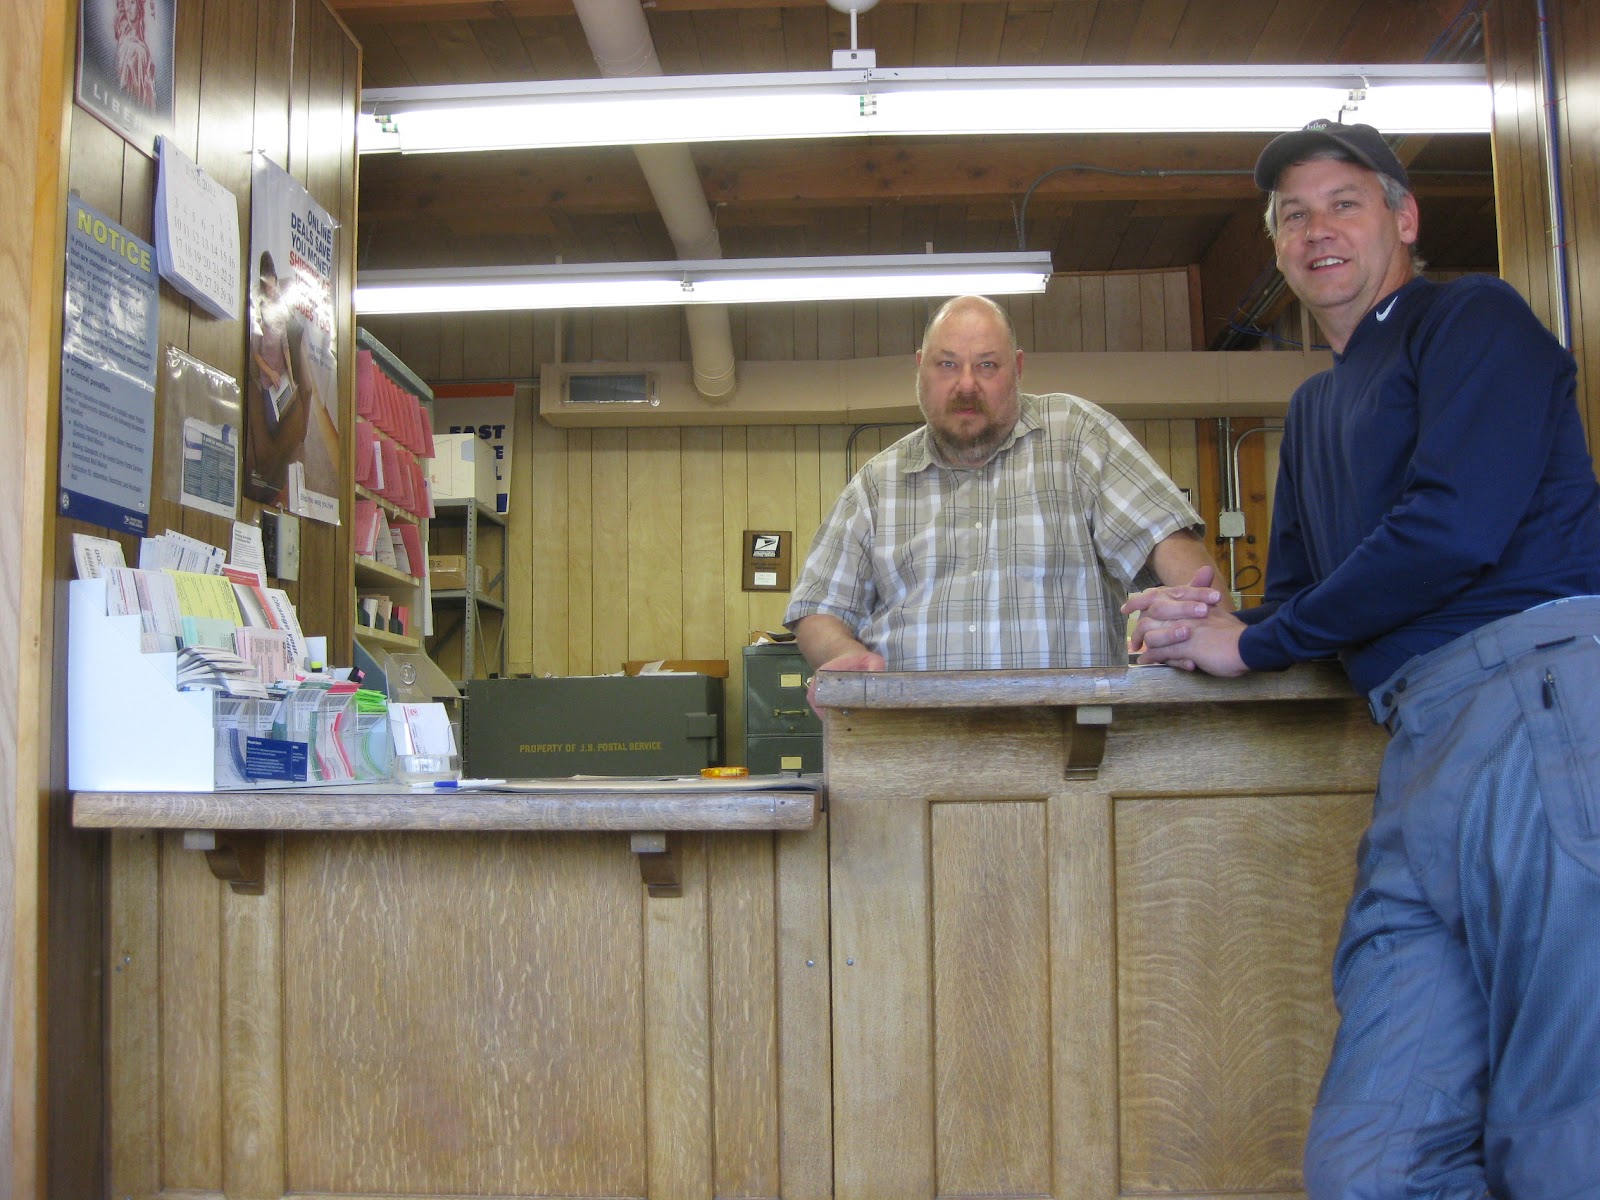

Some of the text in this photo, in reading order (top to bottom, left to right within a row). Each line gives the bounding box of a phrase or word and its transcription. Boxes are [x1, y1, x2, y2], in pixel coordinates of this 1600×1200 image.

[77, 207, 152, 274] NOTICE
[174, 197, 179, 208] 3
[192, 211, 196, 223] 5
[201, 219, 206, 230] 6
[211, 225, 215, 236] 7
[220, 232, 224, 243] 8
[229, 238, 233, 249] 9
[174, 216, 235, 269] 10 11 12 13 14 15 16
[291, 212, 331, 263] DEALS SAVE
[308, 210, 331, 245] ONLINE
[85, 242, 107, 263] knowingly
[176, 236, 235, 288] 17 18 19 20 21 22 23
[291, 230, 331, 279] YOU MONEY
[178, 255, 234, 306] 24 25 26 27 28 29 30
[70, 367, 89, 383] Criminal
[271, 595, 290, 631] Change
[287, 633, 298, 656] your
[519, 743, 562, 753] PROPERTY
[565, 743, 576, 753] OF
[598, 742, 627, 752] POSTAL
[629, 741, 662, 751] SERVICE
